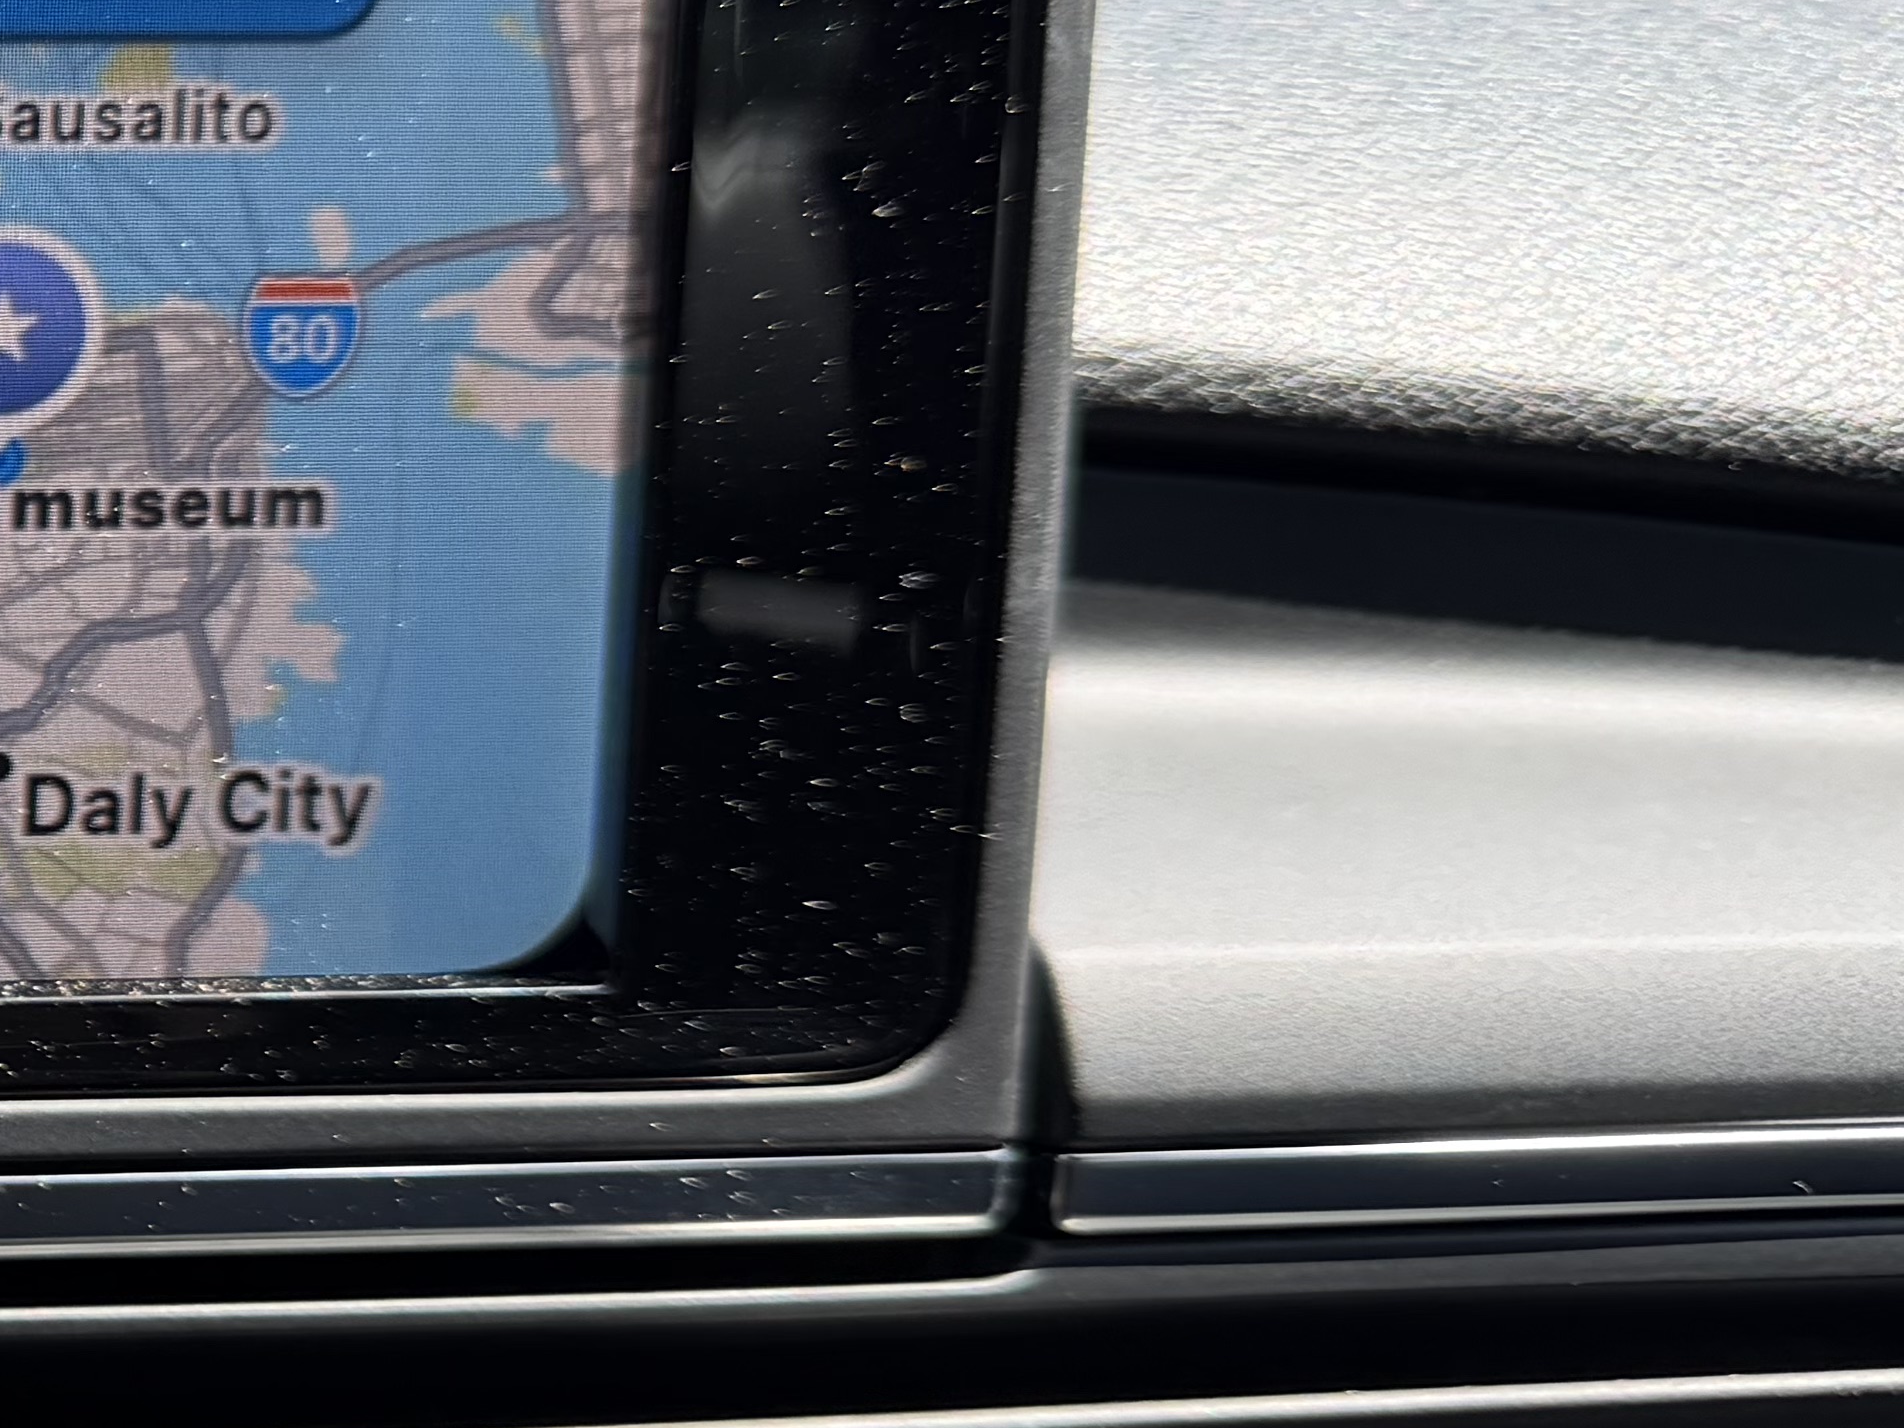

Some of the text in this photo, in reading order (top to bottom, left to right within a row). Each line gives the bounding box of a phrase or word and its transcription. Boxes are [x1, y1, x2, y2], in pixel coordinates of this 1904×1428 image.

[266, 313, 338, 364] 80
[13, 485, 327, 531] museum
[21, 768, 375, 850] Daly City
